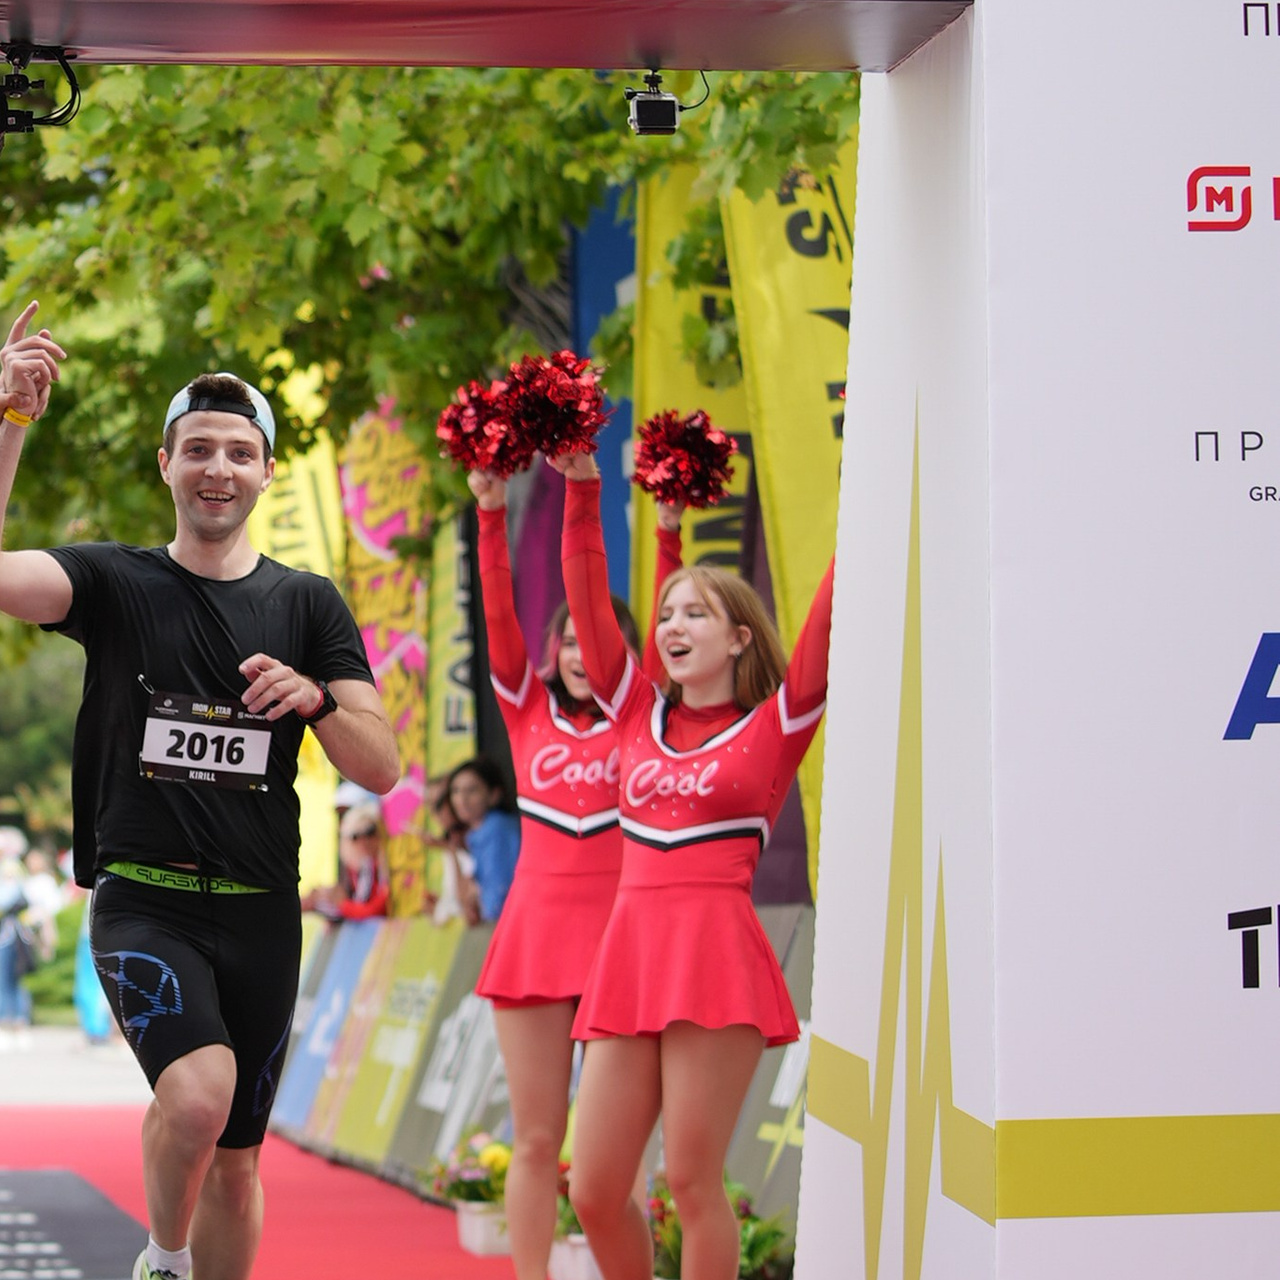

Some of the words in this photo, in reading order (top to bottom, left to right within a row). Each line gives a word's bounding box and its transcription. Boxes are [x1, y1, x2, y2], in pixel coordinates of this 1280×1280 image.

[214, 705, 232, 716] STAR
[166, 729, 245, 766] 2016
[188, 770, 217, 782] KIRILL
[530, 743, 619, 791] Cool
[625, 758, 719, 808] Cool
